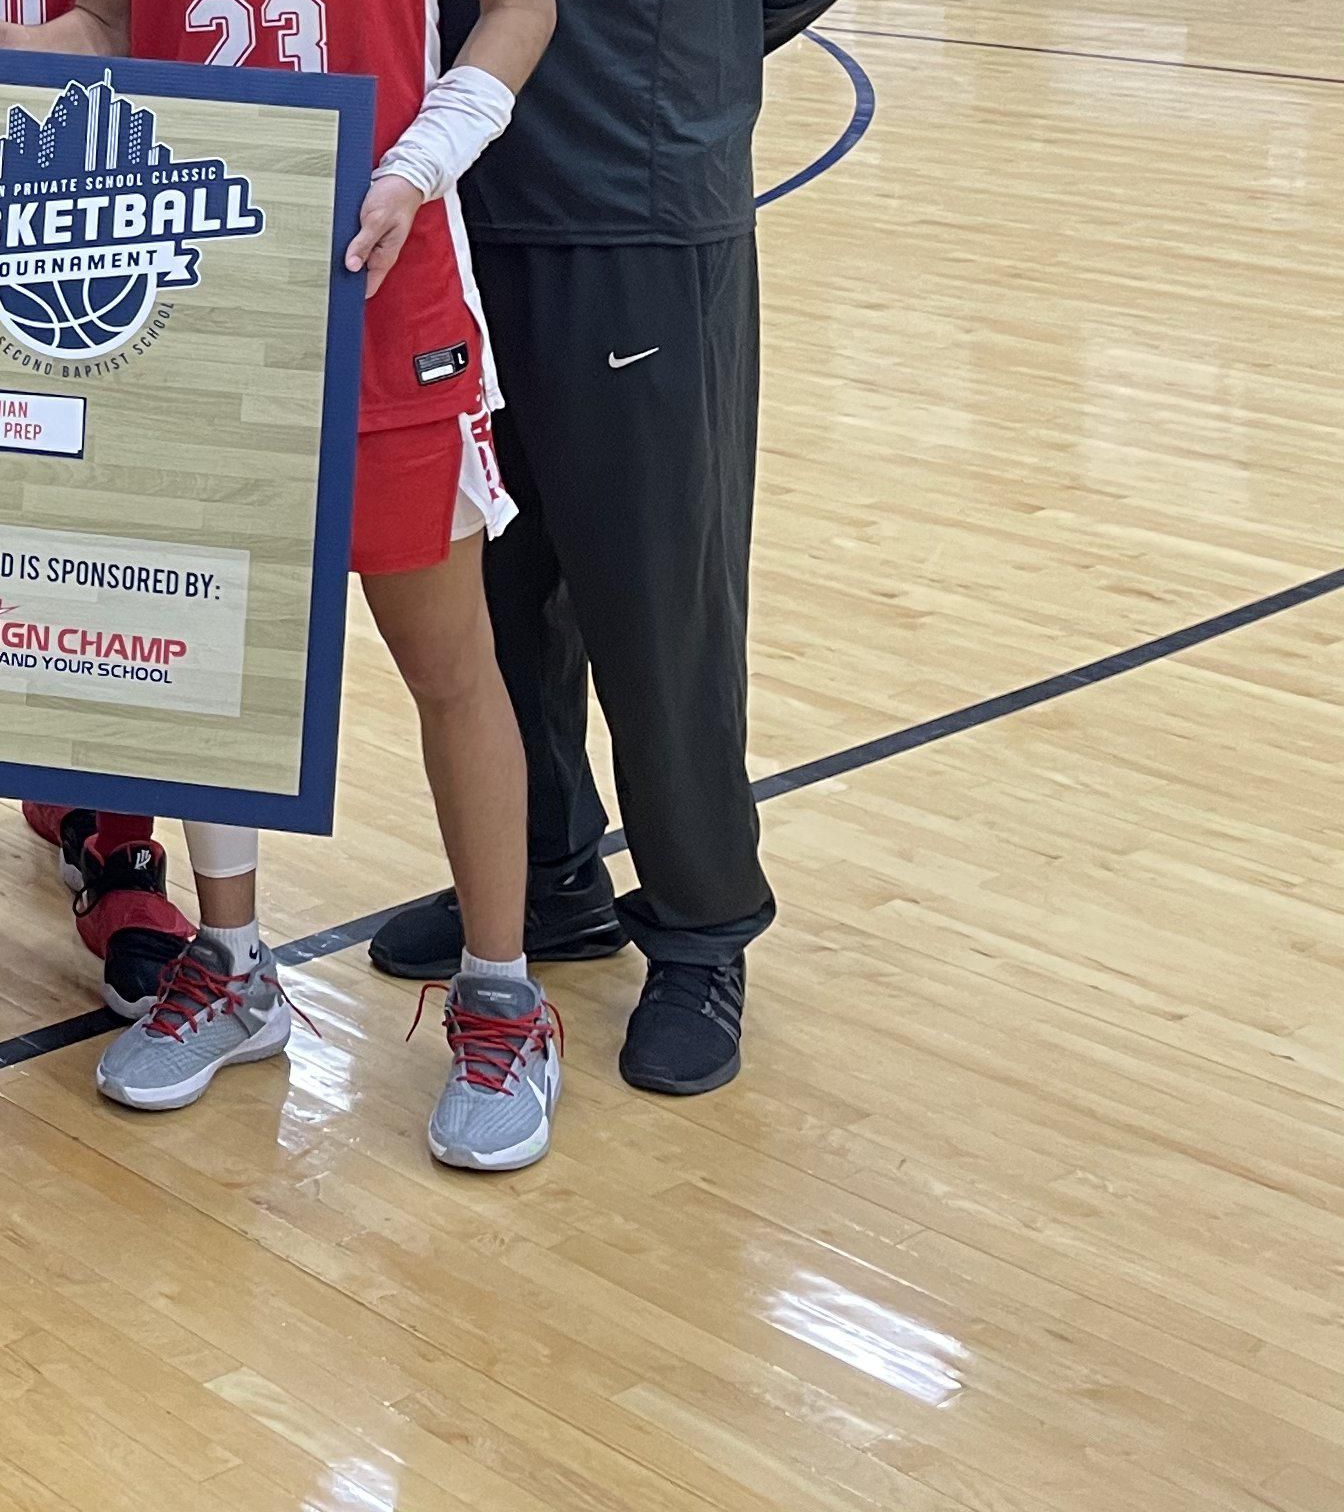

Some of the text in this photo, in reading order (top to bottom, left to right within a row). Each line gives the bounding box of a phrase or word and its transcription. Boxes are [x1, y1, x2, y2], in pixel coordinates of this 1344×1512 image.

[14, 178, 77, 197] PRIVATE
[85, 172, 143, 191] SCHOOL
[151, 166, 217, 184] CLASSIC
[62, 352, 129, 378] BAPTIST
[134, 301, 175, 355] SCHOOL
[4, 422, 42, 440] PREP
[20, 555, 40, 580] IS
[46, 557, 179, 595] SPONSORED
[185, 573, 221, 600] BY:
[57, 628, 187, 665] CHAMP
[42, 656, 94, 676] YOUR
[97, 662, 173, 684] SCHOOL
